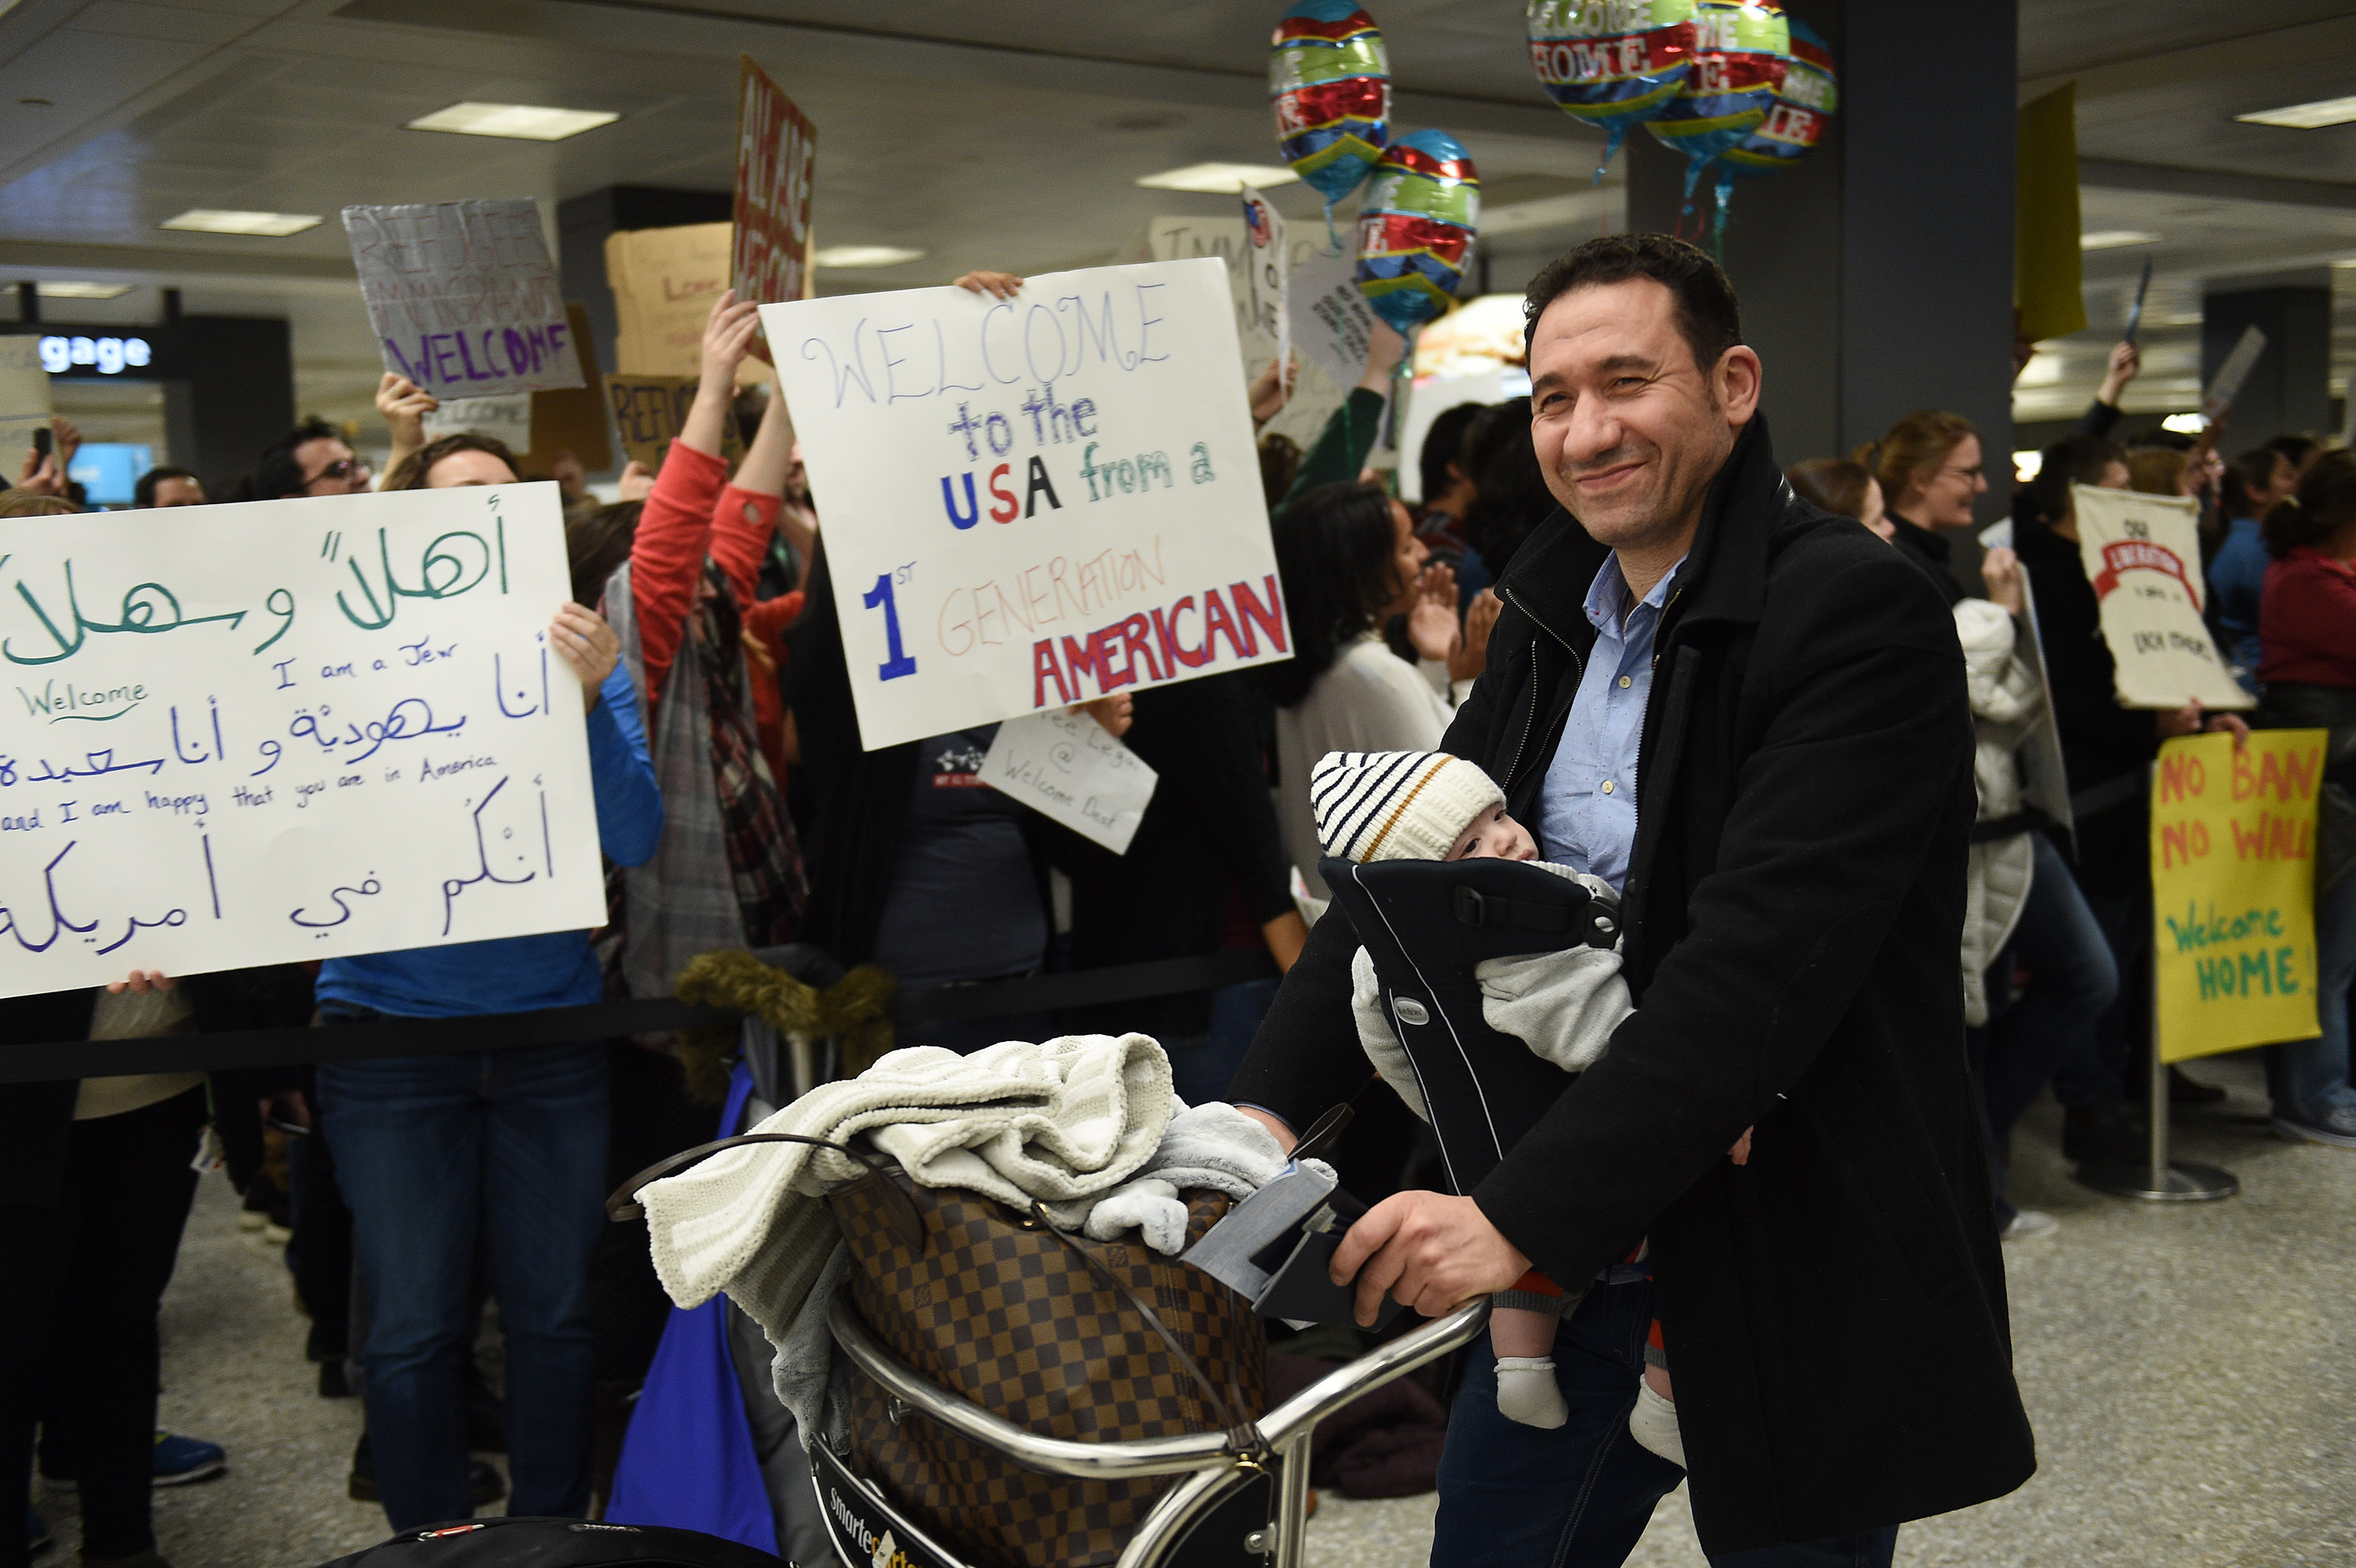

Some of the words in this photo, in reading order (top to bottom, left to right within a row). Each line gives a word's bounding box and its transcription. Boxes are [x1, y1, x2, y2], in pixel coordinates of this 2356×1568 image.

[1532, 38, 1652, 82] HOME
[39, 336, 151, 374] gage
[386, 323, 568, 387] WELCOME
[801, 283, 1171, 409] WELCOME
[949, 400, 1015, 461] to
[1021, 382, 1098, 445] the
[941, 455, 1063, 530] USA
[1079, 442, 1173, 503] from
[1189, 440, 1216, 484] a
[937, 534, 1167, 656] GENERATION
[273, 658, 298, 691] I
[320, 663, 357, 678] am
[372, 659, 388, 671] a
[397, 634, 459, 667] Jew
[1033, 573, 1289, 708] AMERICAN
[16, 678, 151, 718] Welcome
[1004, 747, 1076, 806] Welcome
[1048, 740, 1075, 773] @
[2160, 749, 2206, 806] NO
[2231, 747, 2319, 802] BAN
[1, 808, 45, 832] and
[58, 799, 80, 824] I
[91, 800, 132, 817] am
[145, 790, 209, 816] happy
[232, 784, 274, 807] that
[294, 780, 326, 809] you
[337, 773, 364, 788] are
[384, 766, 402, 782] in
[419, 755, 498, 784] America
[2162, 819, 2211, 871] NO
[2230, 810, 2313, 862] WALL
[2165, 897, 2285, 955] Welcome
